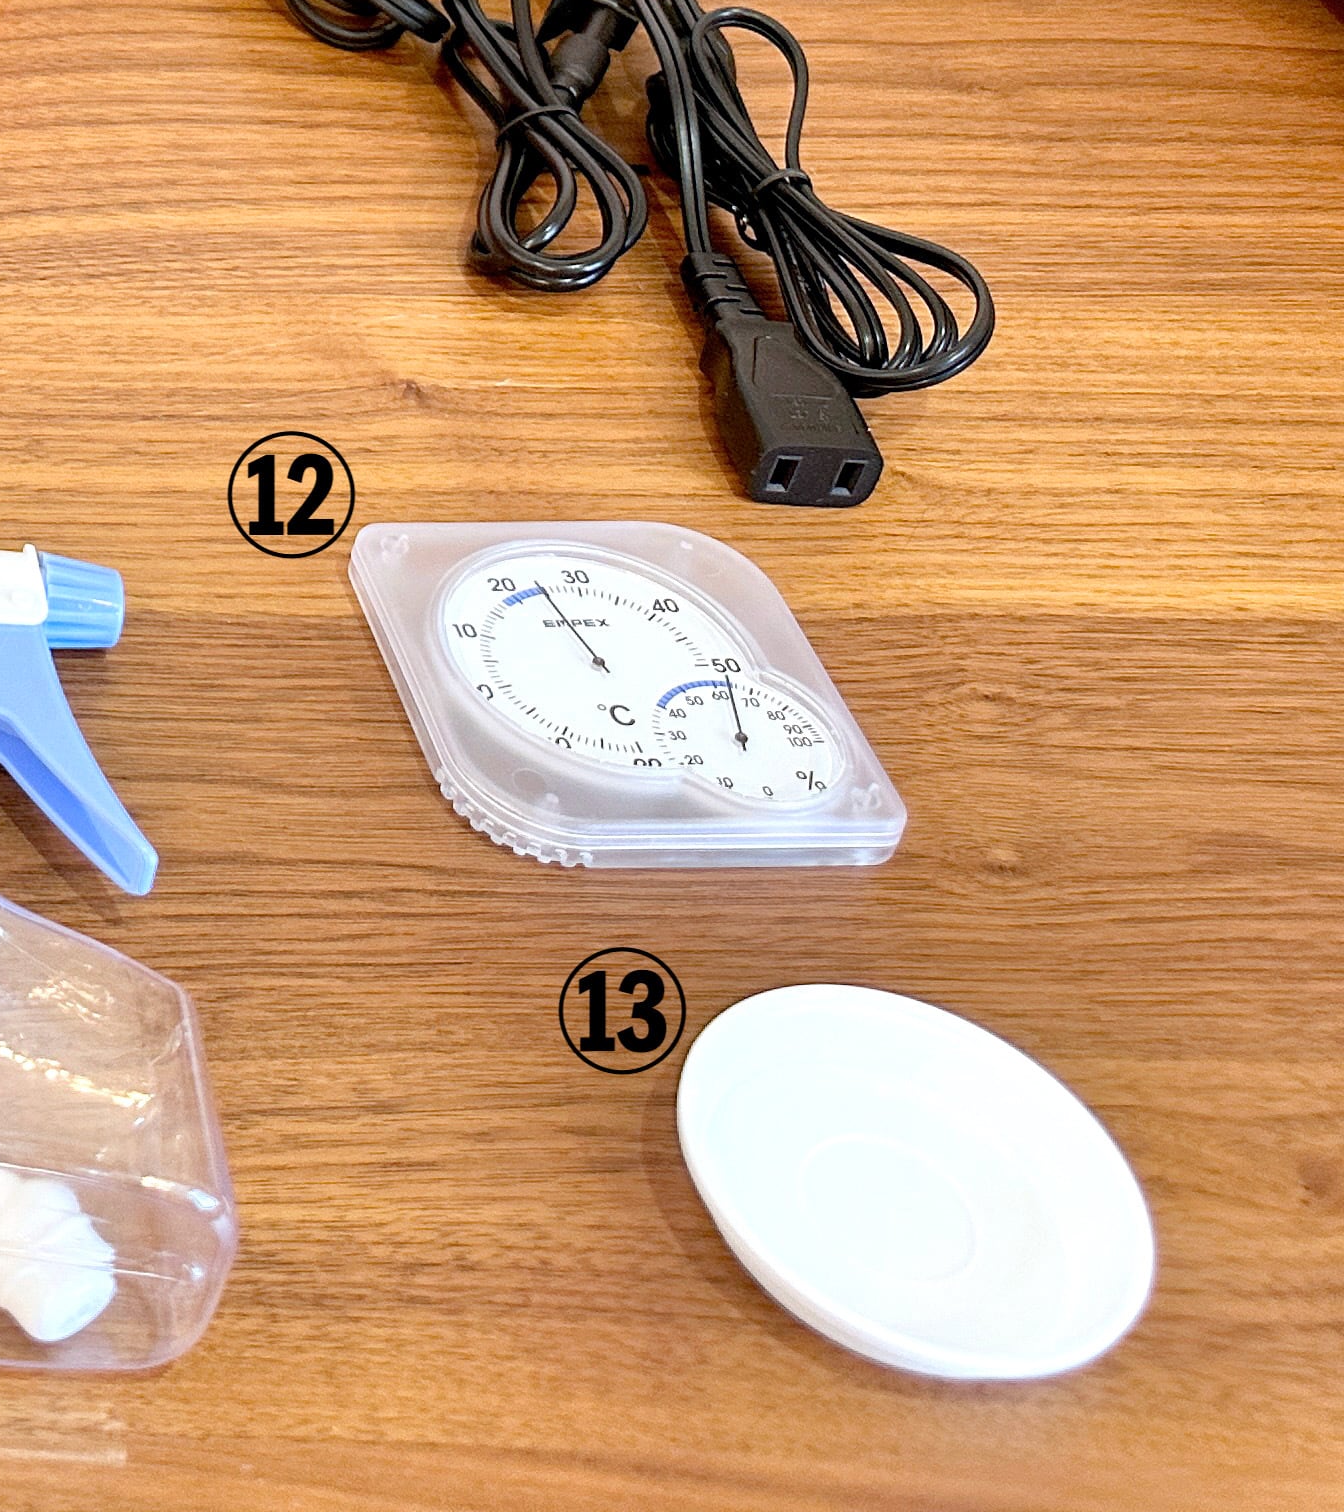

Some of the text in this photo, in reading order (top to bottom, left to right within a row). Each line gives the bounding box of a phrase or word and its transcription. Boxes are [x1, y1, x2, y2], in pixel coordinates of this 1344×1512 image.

[560, 569, 590, 585] 30
[486, 577, 516, 593] 20
[652, 598, 680, 614] 40
[452, 623, 478, 639] 10
[711, 658, 742, 674] 50
[685, 695, 705, 707] 50
[711, 690, 730, 701] 60
[741, 697, 761, 708] 70
[668, 708, 687, 719] 40
[766, 710, 786, 721] 80
[667, 730, 687, 741] 30
[783, 724, 803, 736] 90
[787, 737, 813, 748] 100
